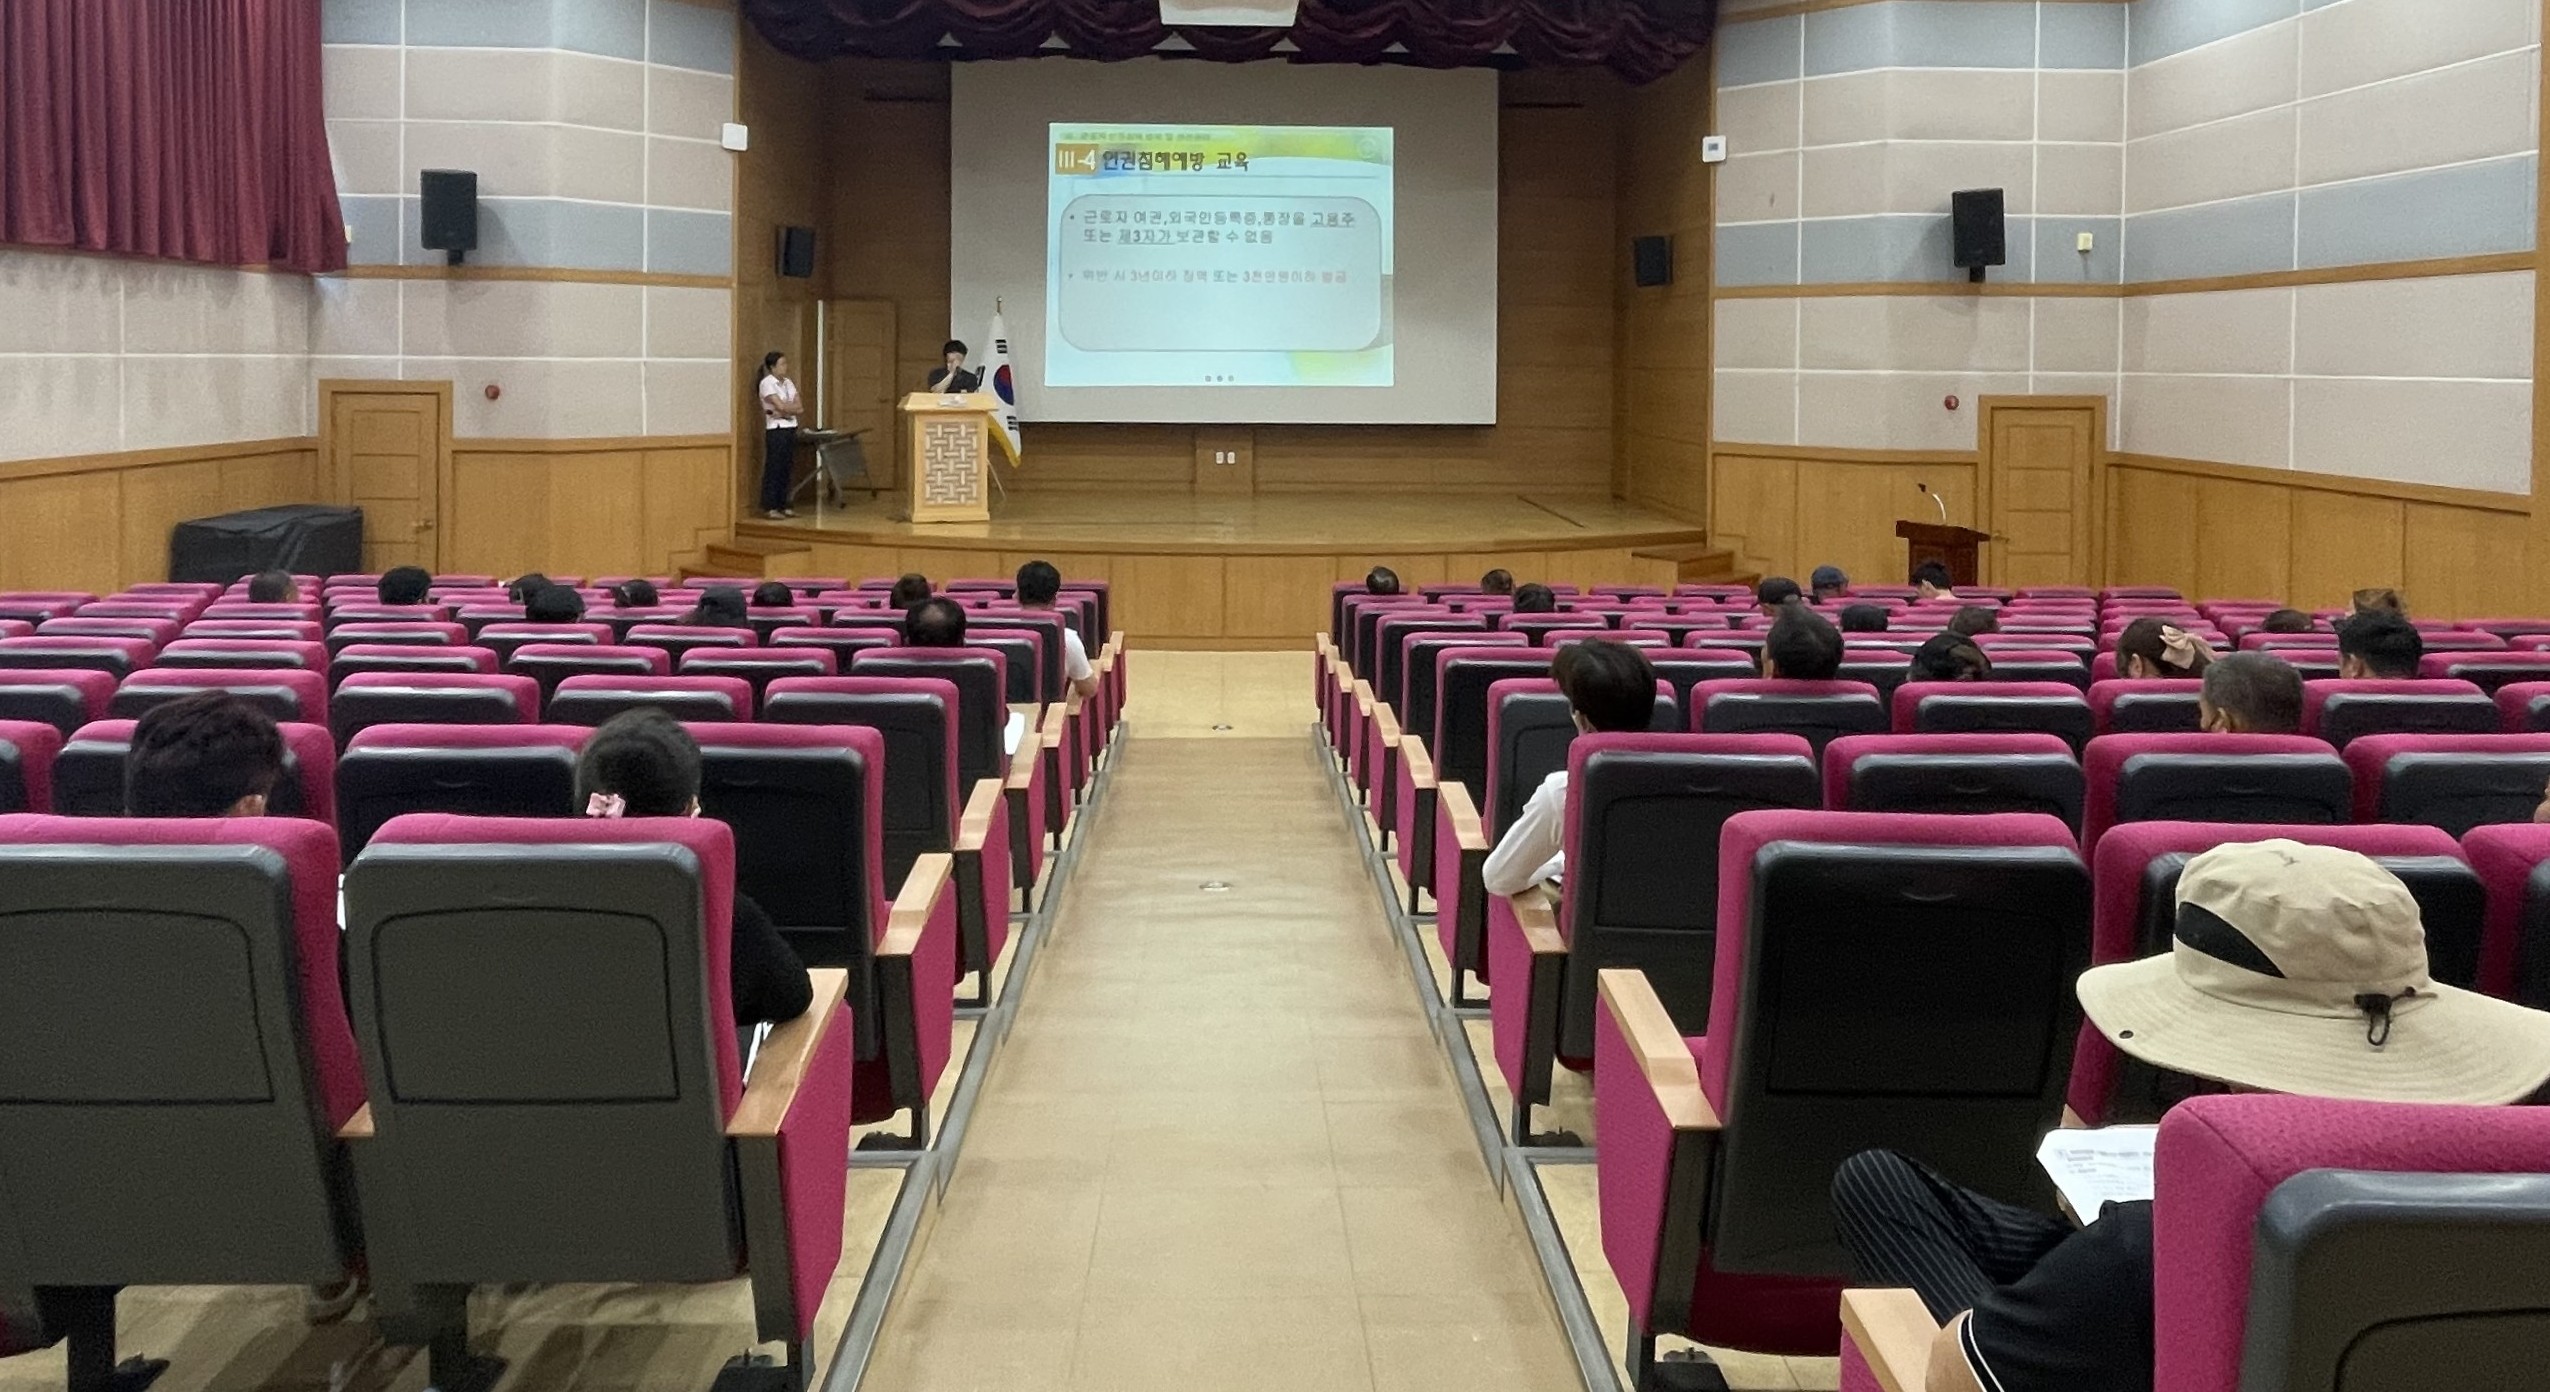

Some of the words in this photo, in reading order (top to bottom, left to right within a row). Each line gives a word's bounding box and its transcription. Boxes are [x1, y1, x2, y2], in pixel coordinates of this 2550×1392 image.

[1103, 151, 1205, 171] 인권침해예방
[1216, 152, 1249, 171] 교육
[1084, 210, 1127, 224] 근로자
[1312, 211, 1354, 226] 고용주
[1084, 229, 1111, 242] 또는
[1118, 229, 1172, 243] 제3자가
[1177, 230, 1219, 243] 보관할
[1226, 230, 1239, 243] 수
[1245, 230, 1272, 244] 없음
[1114, 270, 1125, 282] 시
[1213, 270, 1238, 283] 또는
